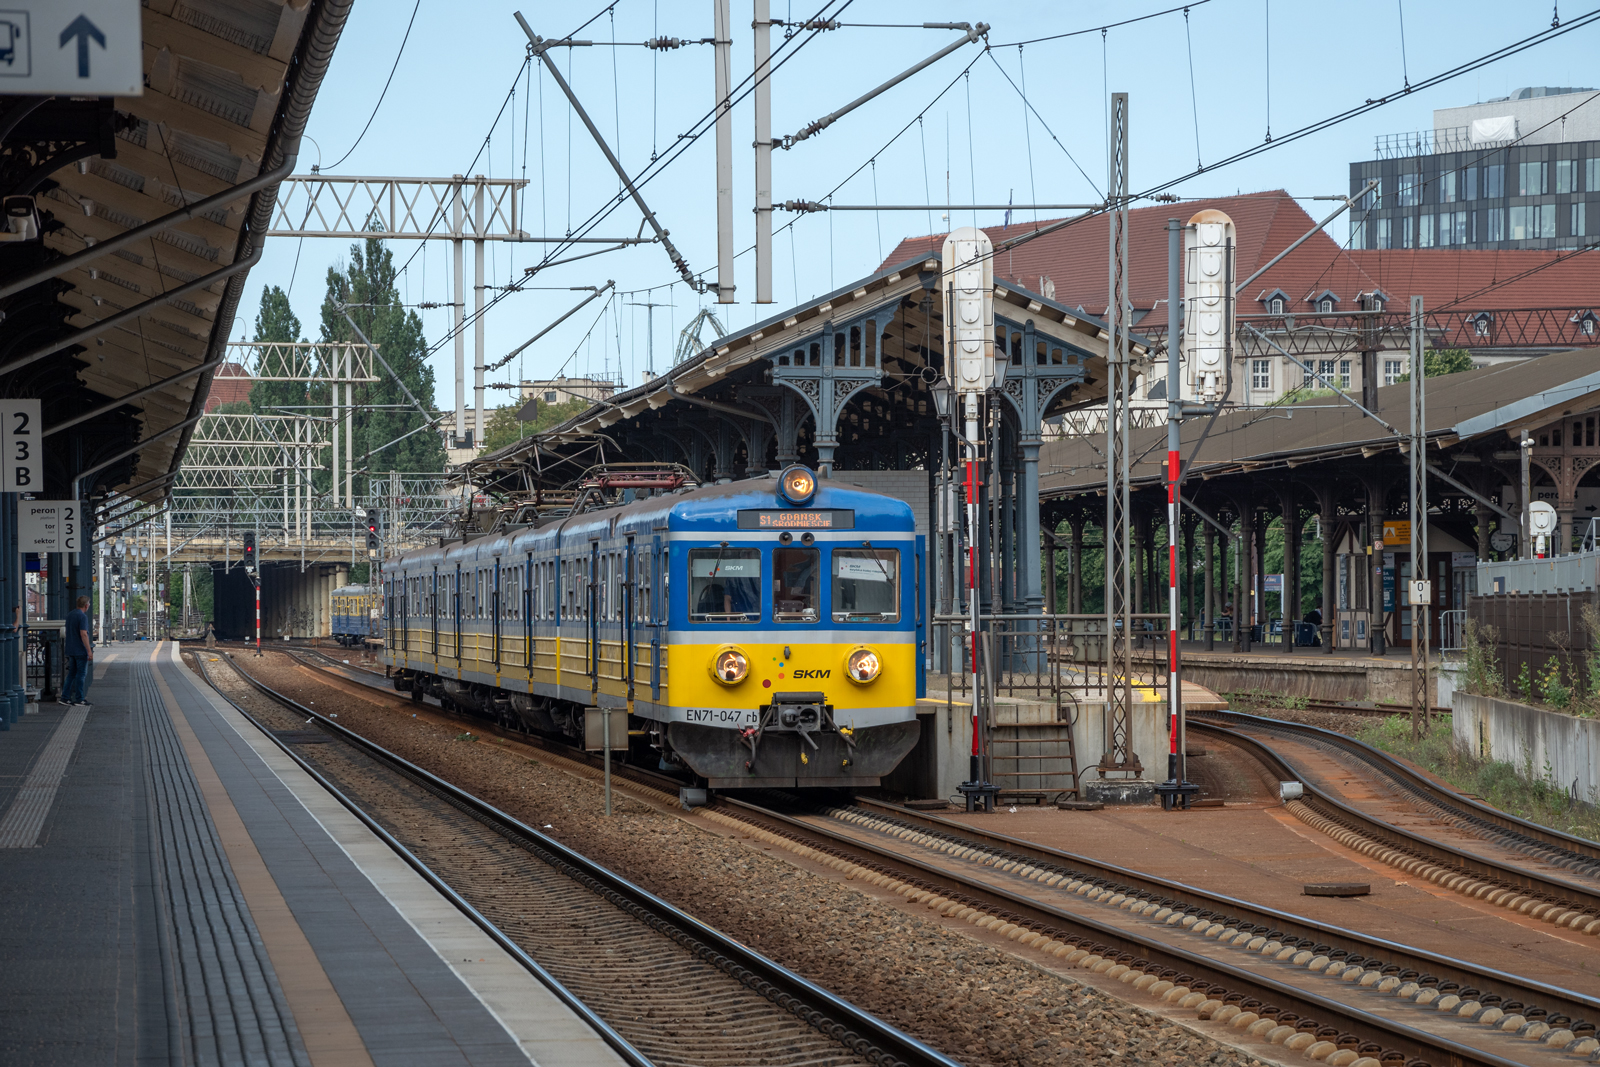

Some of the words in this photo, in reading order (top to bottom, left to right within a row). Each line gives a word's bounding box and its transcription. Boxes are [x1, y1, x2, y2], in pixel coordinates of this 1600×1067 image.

[13, 412, 30, 435] 2
[15, 441, 29, 460] 3
[15, 467, 31, 486] B
[1538, 492, 1559, 500] pero
[64, 507, 74, 520] 2
[760, 515, 771, 525] S1
[65, 524, 74, 535] 3
[1573, 526, 1578, 534] 5
[65, 538, 74, 549] C
[1417, 582, 1423, 591] 0
[1419, 594, 1423, 603] 1
[793, 670, 831, 678] SKM
[686, 710, 741, 721] EN71-047
[746, 712, 757, 722] rb
